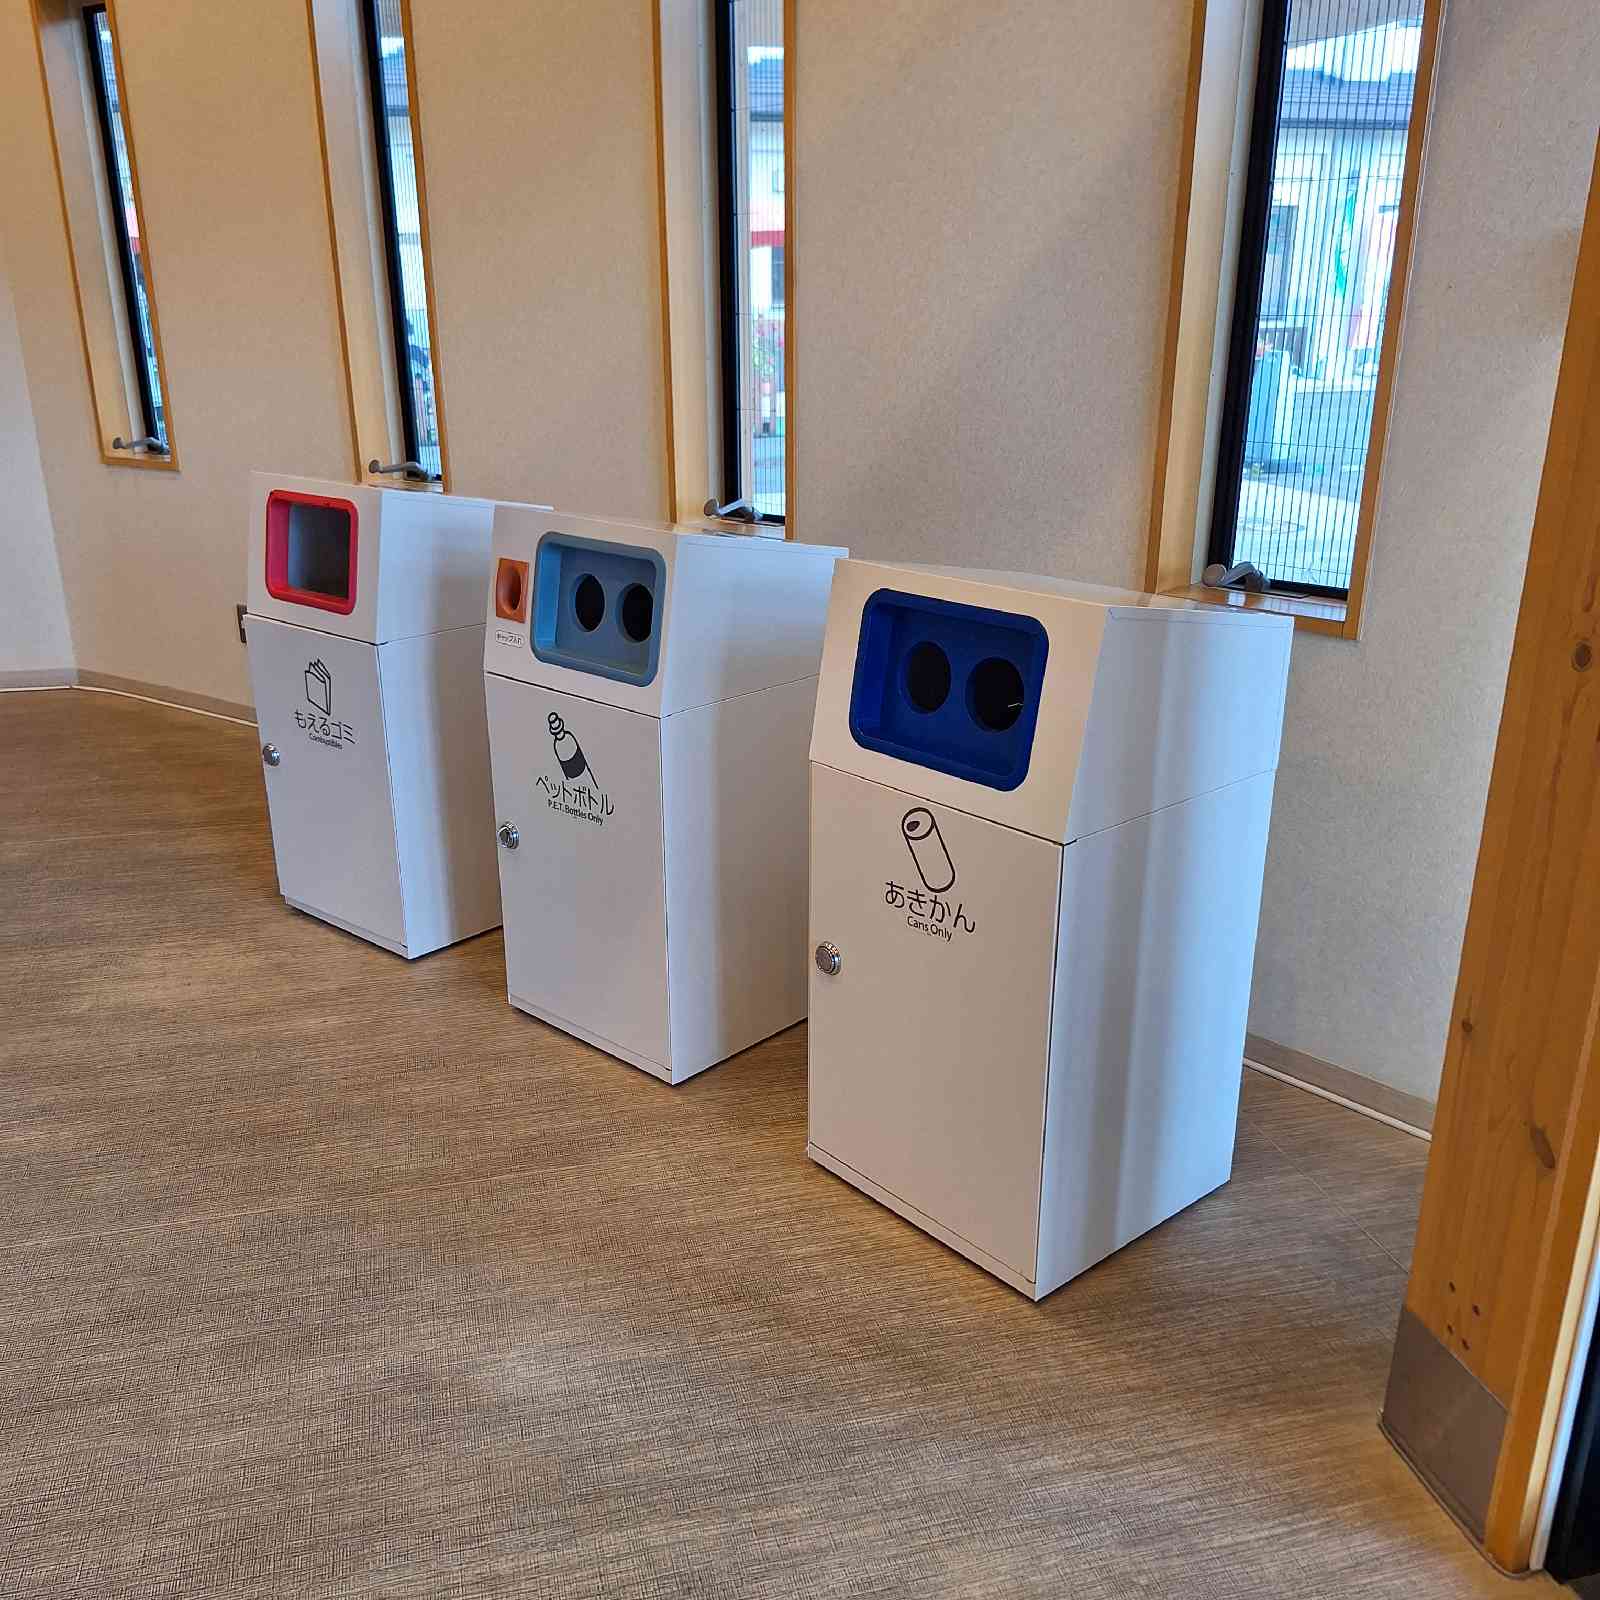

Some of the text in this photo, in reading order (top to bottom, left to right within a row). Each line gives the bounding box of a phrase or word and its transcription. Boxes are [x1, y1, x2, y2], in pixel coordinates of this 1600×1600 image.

[294, 709, 355, 744] もえるゴミ
[536, 776, 614, 815] ペットボトル
[564, 804, 587, 819] Bottles
[588, 813, 603, 826] Only
[885, 881, 975, 933] あきかん
[907, 916, 953, 942] Cans Only
